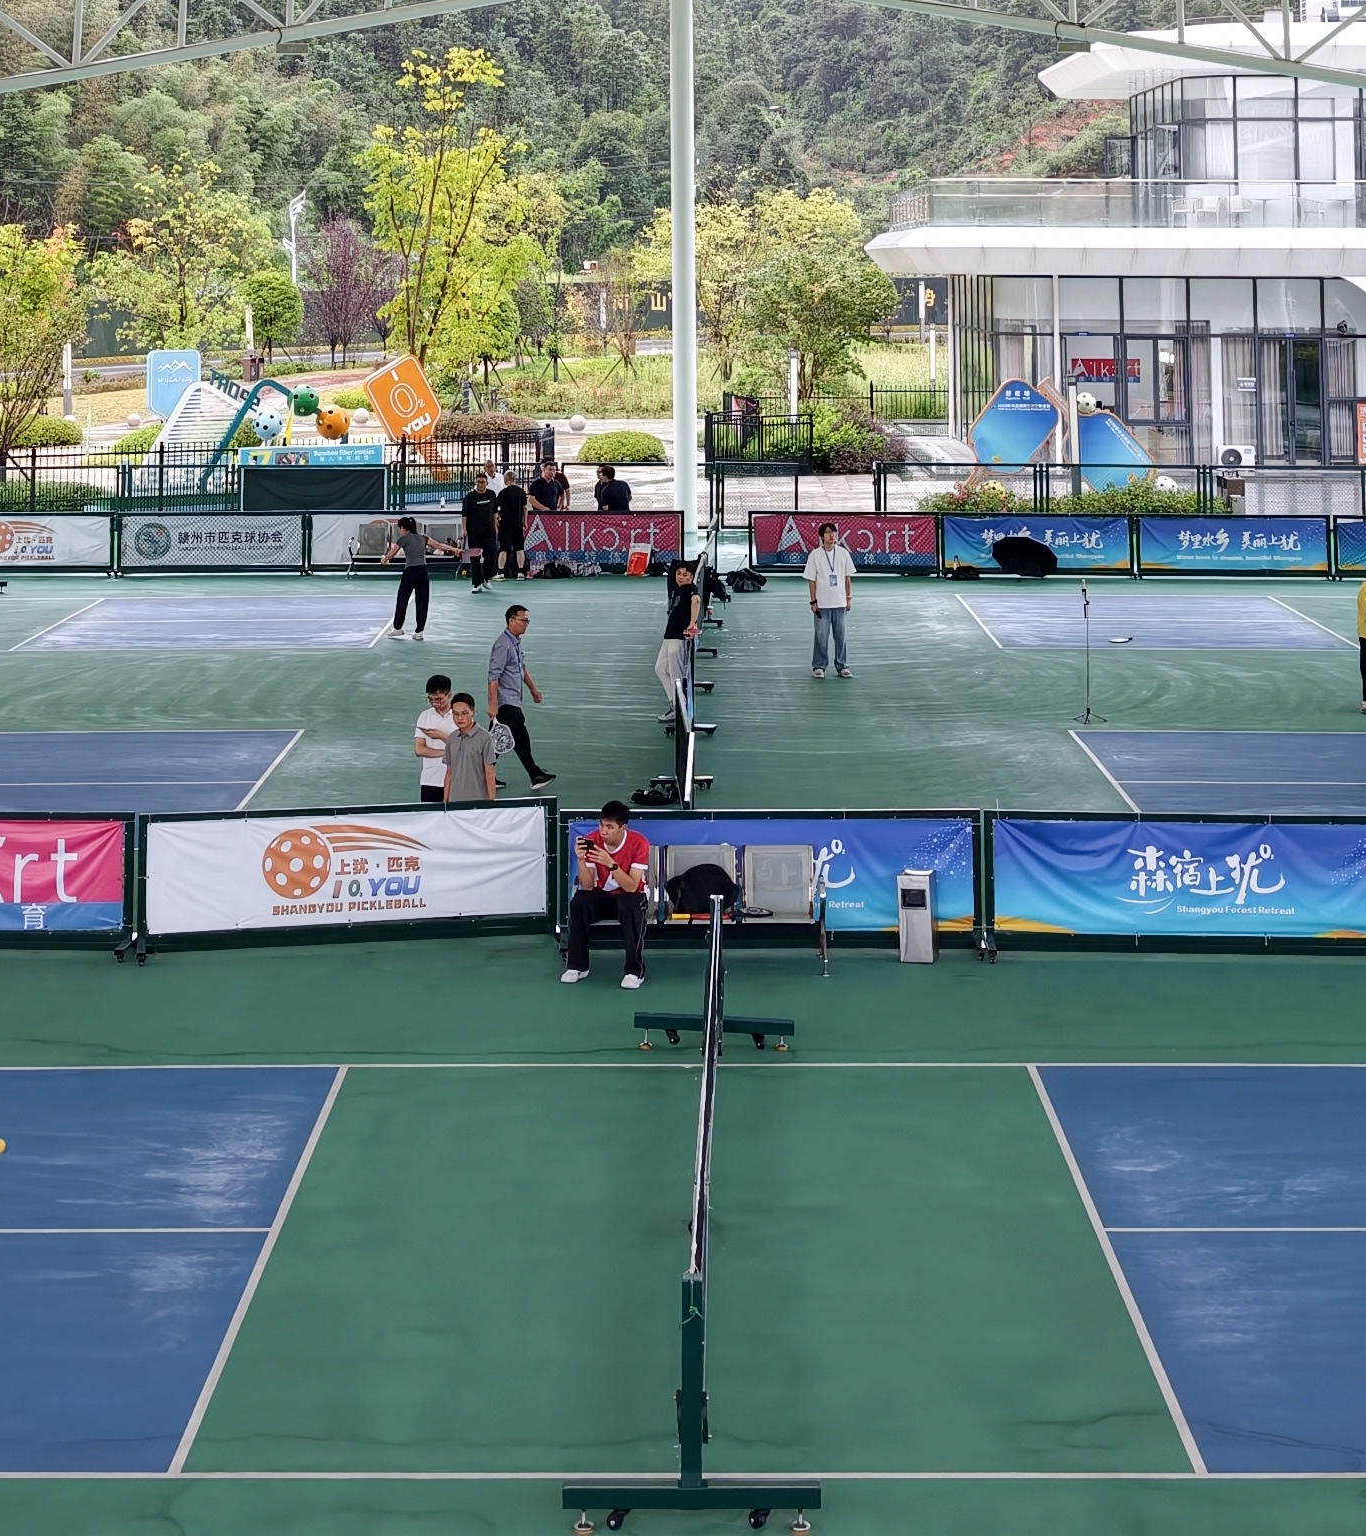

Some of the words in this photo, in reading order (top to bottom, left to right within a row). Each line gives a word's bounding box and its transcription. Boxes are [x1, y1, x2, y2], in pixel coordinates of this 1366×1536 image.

[401, 412, 432, 436] YOU
[1176, 527, 1230, 554] 梦里水乡
[1240, 530, 1302, 552] 美丽上犹
[30, 545, 54, 555] YOU
[1126, 845, 1286, 905] 森宿上犹
[368, 875, 422, 897] YOU
[348, 897, 427, 912] PICKLEBALL
[828, 900, 865, 909] Retreat
[1176, 905, 1224, 916] Shangyou
[1225, 905, 1257, 915] Forest
[1258, 906, 1295, 916] Retreat
